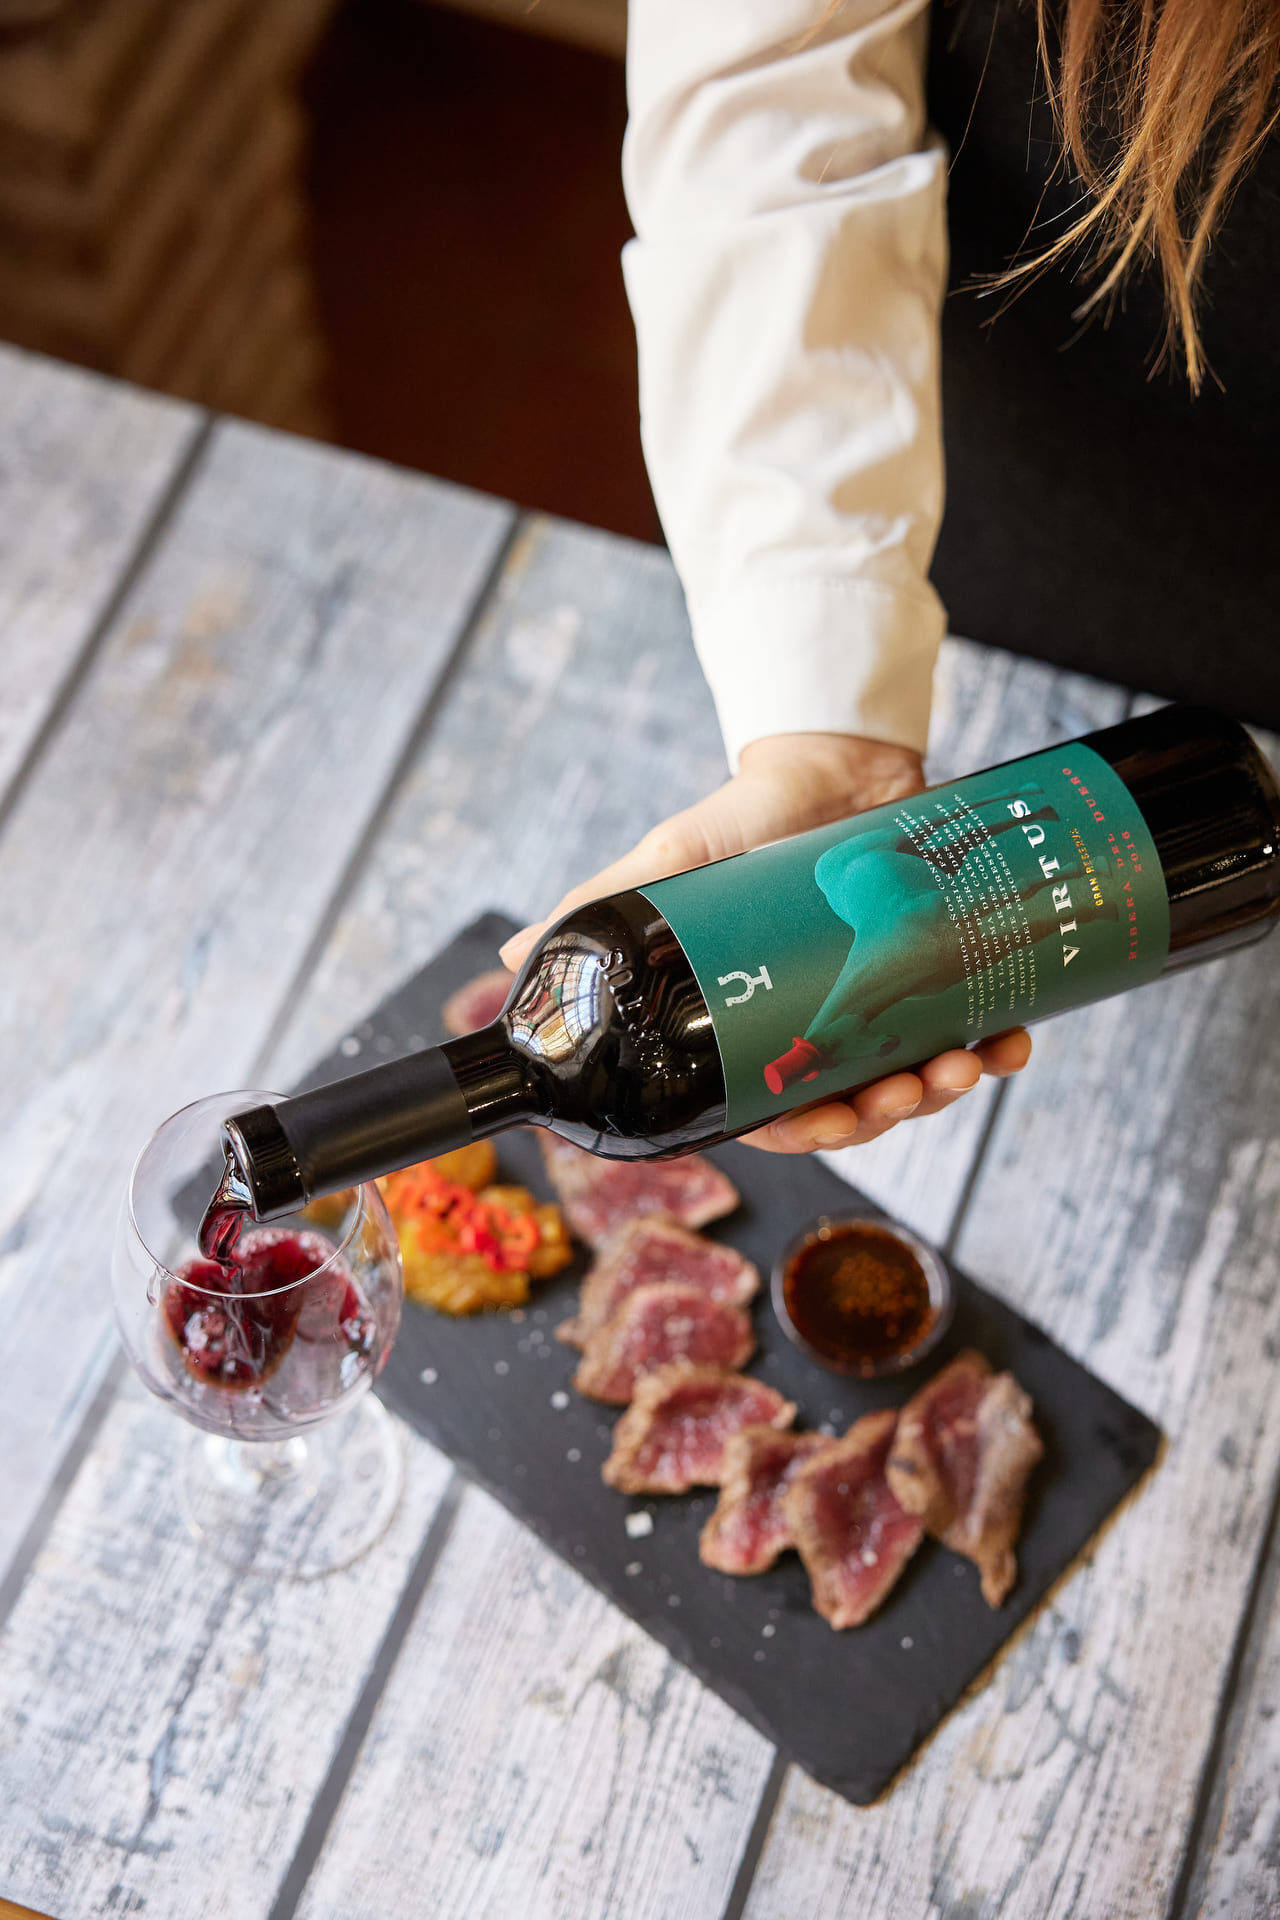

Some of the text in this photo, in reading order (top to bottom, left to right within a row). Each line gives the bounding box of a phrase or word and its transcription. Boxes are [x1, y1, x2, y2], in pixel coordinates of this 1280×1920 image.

[934, 803, 974, 850] LENGUAJE
[1122, 831, 1142, 873] 2016
[973, 856, 989, 880] CON
[996, 852, 1024, 911] PROCESO
[1007, 800, 1080, 967] VIRTUS
[1062, 768, 1138, 960] RIBERA DEL DUERO
[1070, 828, 1104, 906] GRAN RESERVA
[893, 817, 975, 1025] HACE MUCHOS AÑOS CONFLUYERON
[920, 815, 996, 1010] LA COSECHA DE GRANDES VINOS
[946, 872, 976, 944] HISTORIAS
[954, 808, 1026, 994] PROPIO QUE REPRESENTAN LA
[979, 892, 989, 910] DE
[987, 885, 1006, 927] ARTES
[987, 916, 1001, 954] DOMA
[1022, 917, 1032, 944] DEL
[973, 950, 985, 1005] BONITAS
[997, 960, 1004, 976] LA
[1004, 934, 1015, 984] BELLAS
[1028, 949, 1037, 1007] ALQUIMIA
